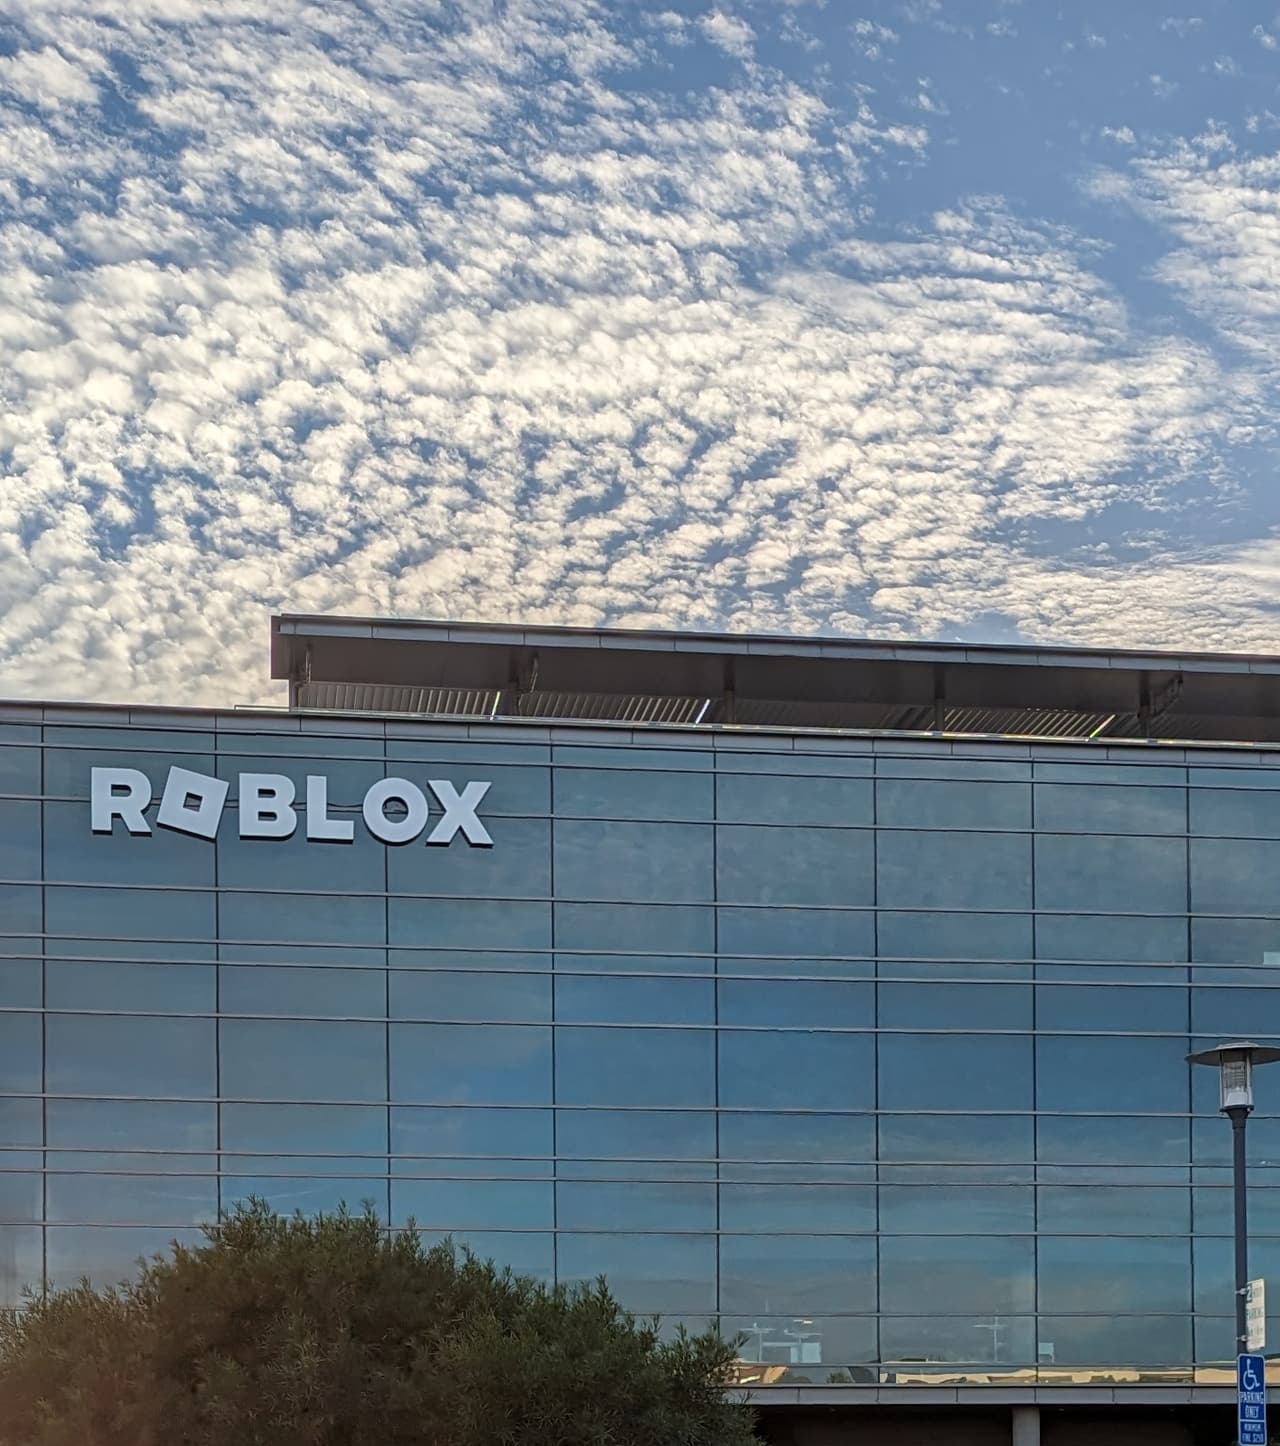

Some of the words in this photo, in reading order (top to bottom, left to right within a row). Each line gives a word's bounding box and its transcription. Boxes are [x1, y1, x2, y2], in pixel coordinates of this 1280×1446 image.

[91, 766, 494, 847] ROBLOX
[1239, 1391, 1264, 1404] PARKING
[1245, 1404, 1259, 1418] ONLY
